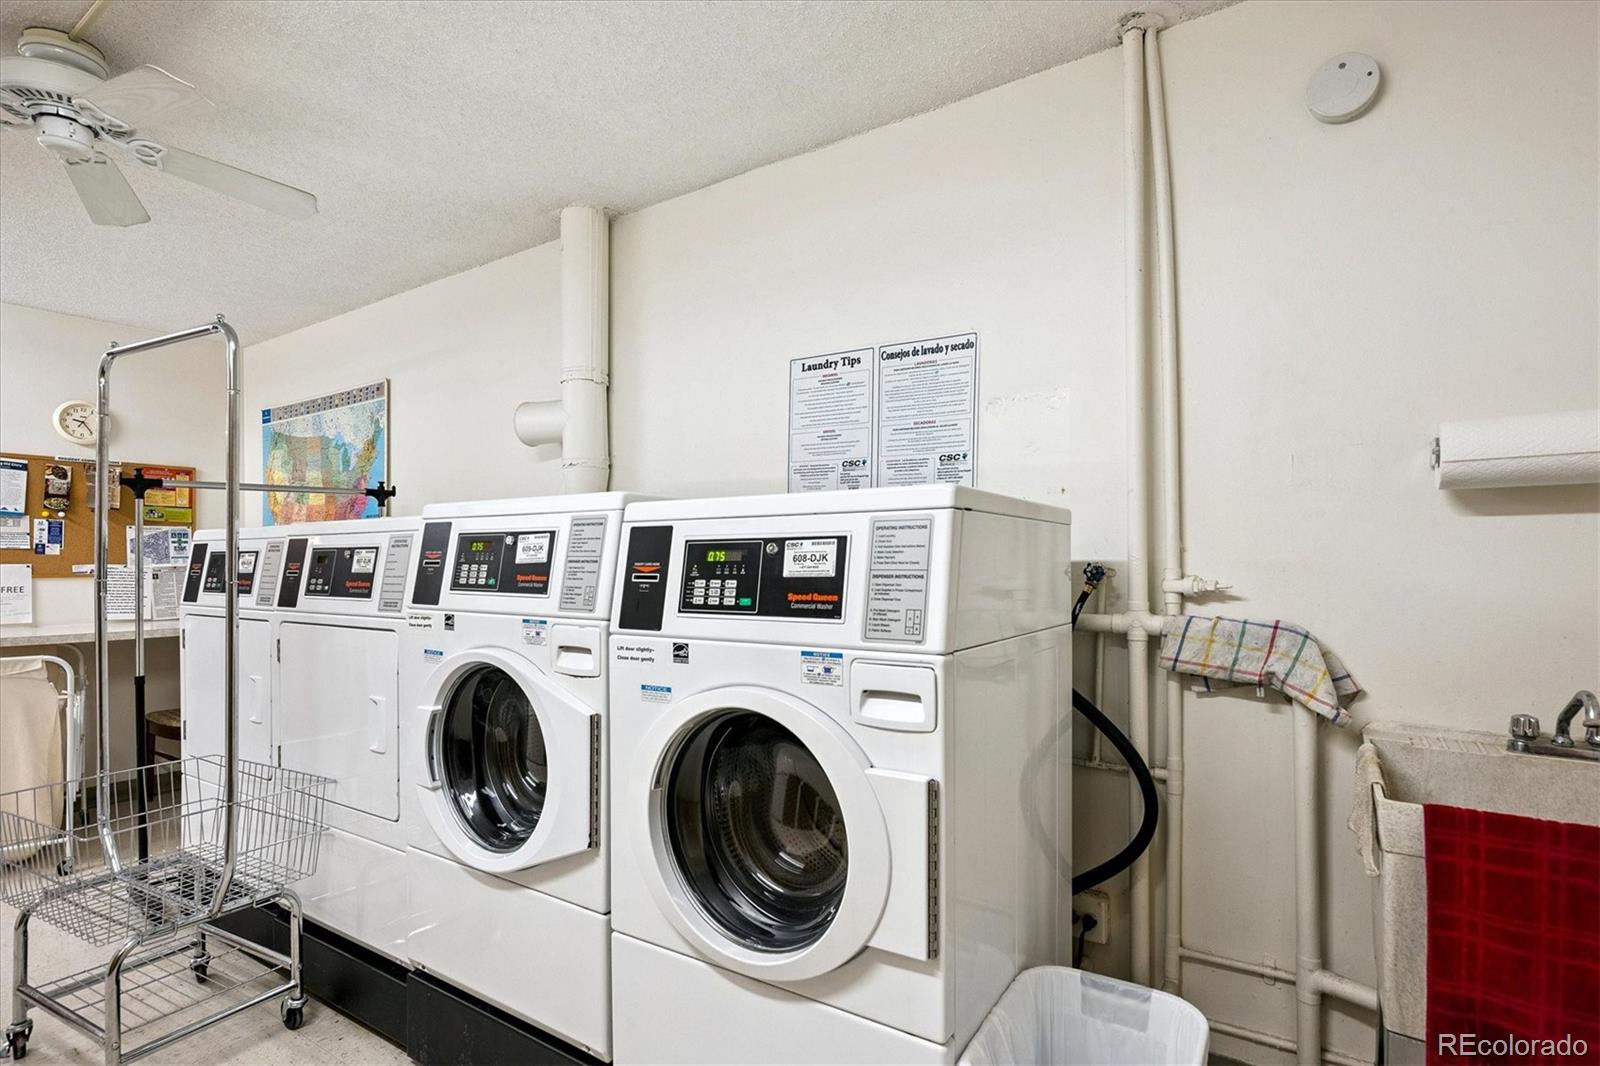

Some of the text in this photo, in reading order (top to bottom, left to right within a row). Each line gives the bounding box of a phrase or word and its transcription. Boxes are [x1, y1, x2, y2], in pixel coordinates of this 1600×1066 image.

[881, 338, 975, 361] Consejos de lavado y secado
[801, 356, 861, 372] Laundry Tips
[939, 453, 961, 462] CSC
[841, 459, 861, 468] CSC
[792, 553, 829, 562] 608-DJK
[787, 593, 838, 601] Speed Queen
